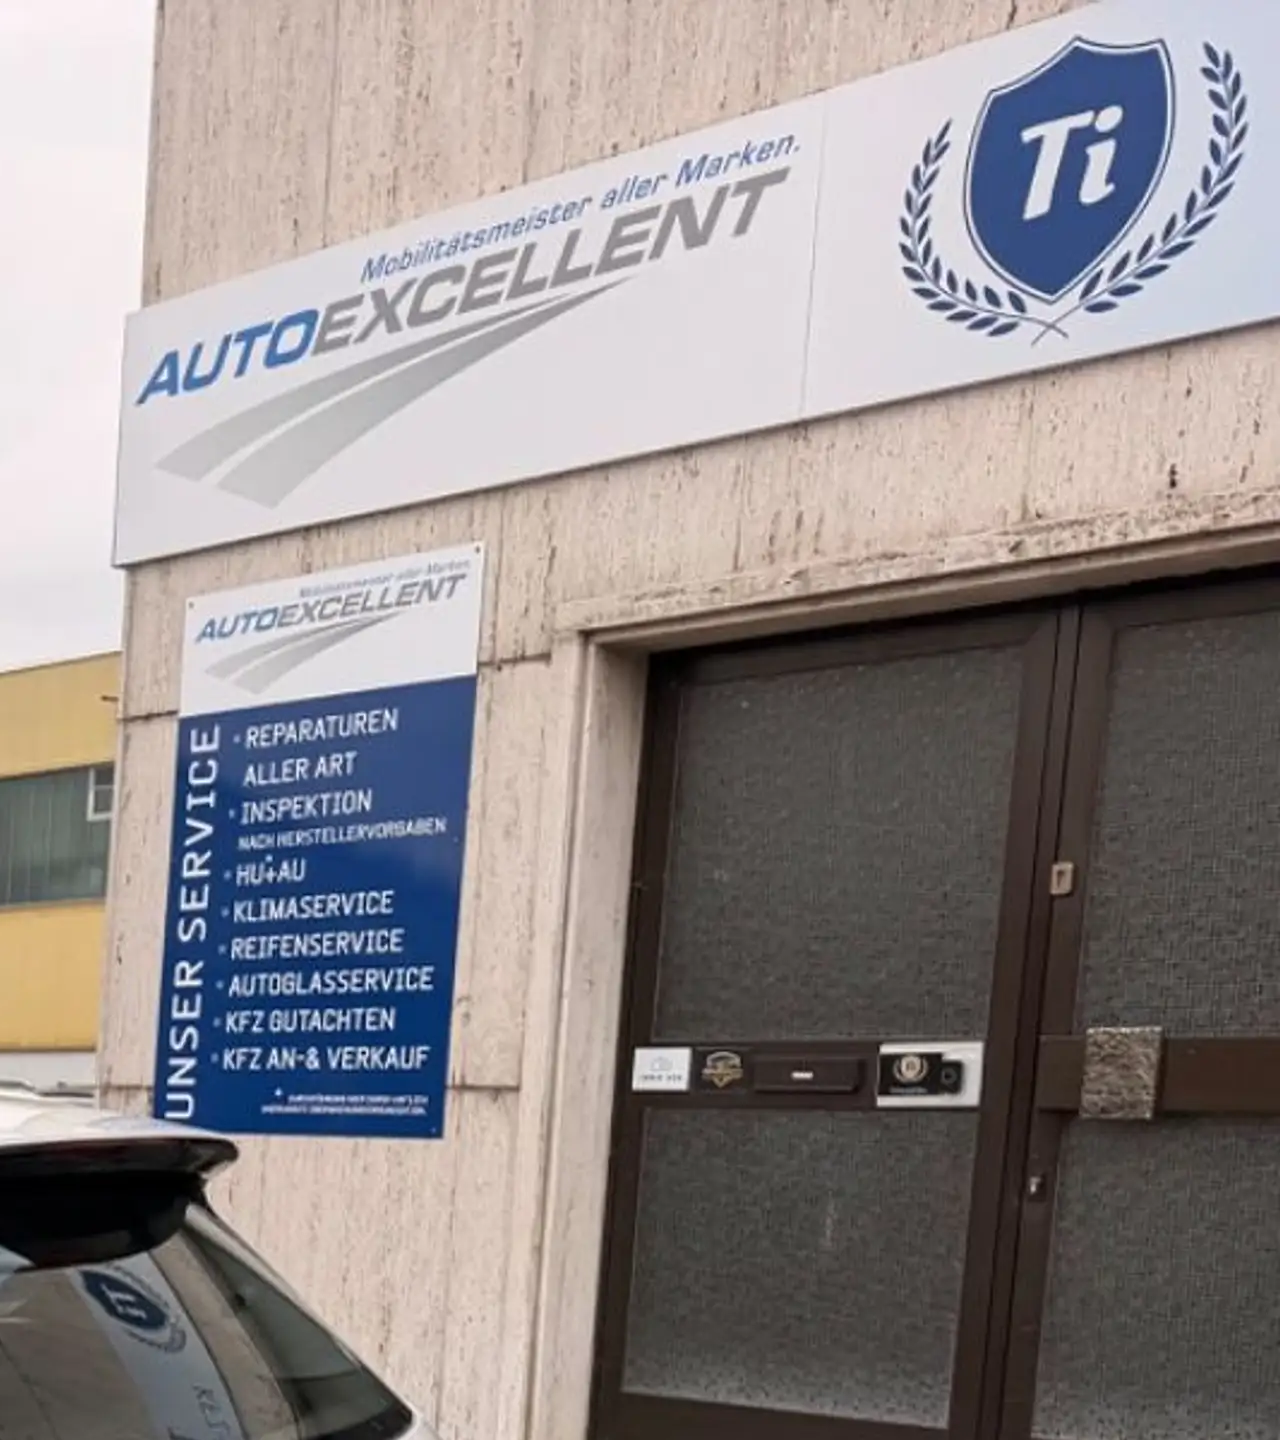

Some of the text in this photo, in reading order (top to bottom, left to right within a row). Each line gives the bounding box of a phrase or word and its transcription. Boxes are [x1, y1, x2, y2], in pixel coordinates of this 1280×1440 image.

[1020, 104, 1124, 222] Ti
[359, 133, 802, 284] Mobilitätsmeister aller Marken.
[136, 165, 791, 406] AUTOEXCELLENT
[195, 573, 467, 643] AUTOEXCELLENT
[245, 706, 399, 750] REPARATUREN
[243, 750, 358, 788] ALLER ART
[240, 788, 373, 826] INSPEKTION
[238, 817, 448, 851] NACH HERSTELLERVORGABEN
[165, 723, 220, 1121] UNSER SERVICE
[233, 889, 395, 924] KLIMASERVICE
[230, 928, 406, 961] REIFENSERVICE
[228, 965, 435, 998] AUTOGLASSERVICE
[225, 1006, 396, 1034] KFZ GUTACHTEN
[223, 1047, 262, 1071] KFZ
[327, 1045, 432, 1071] VERKAUF
